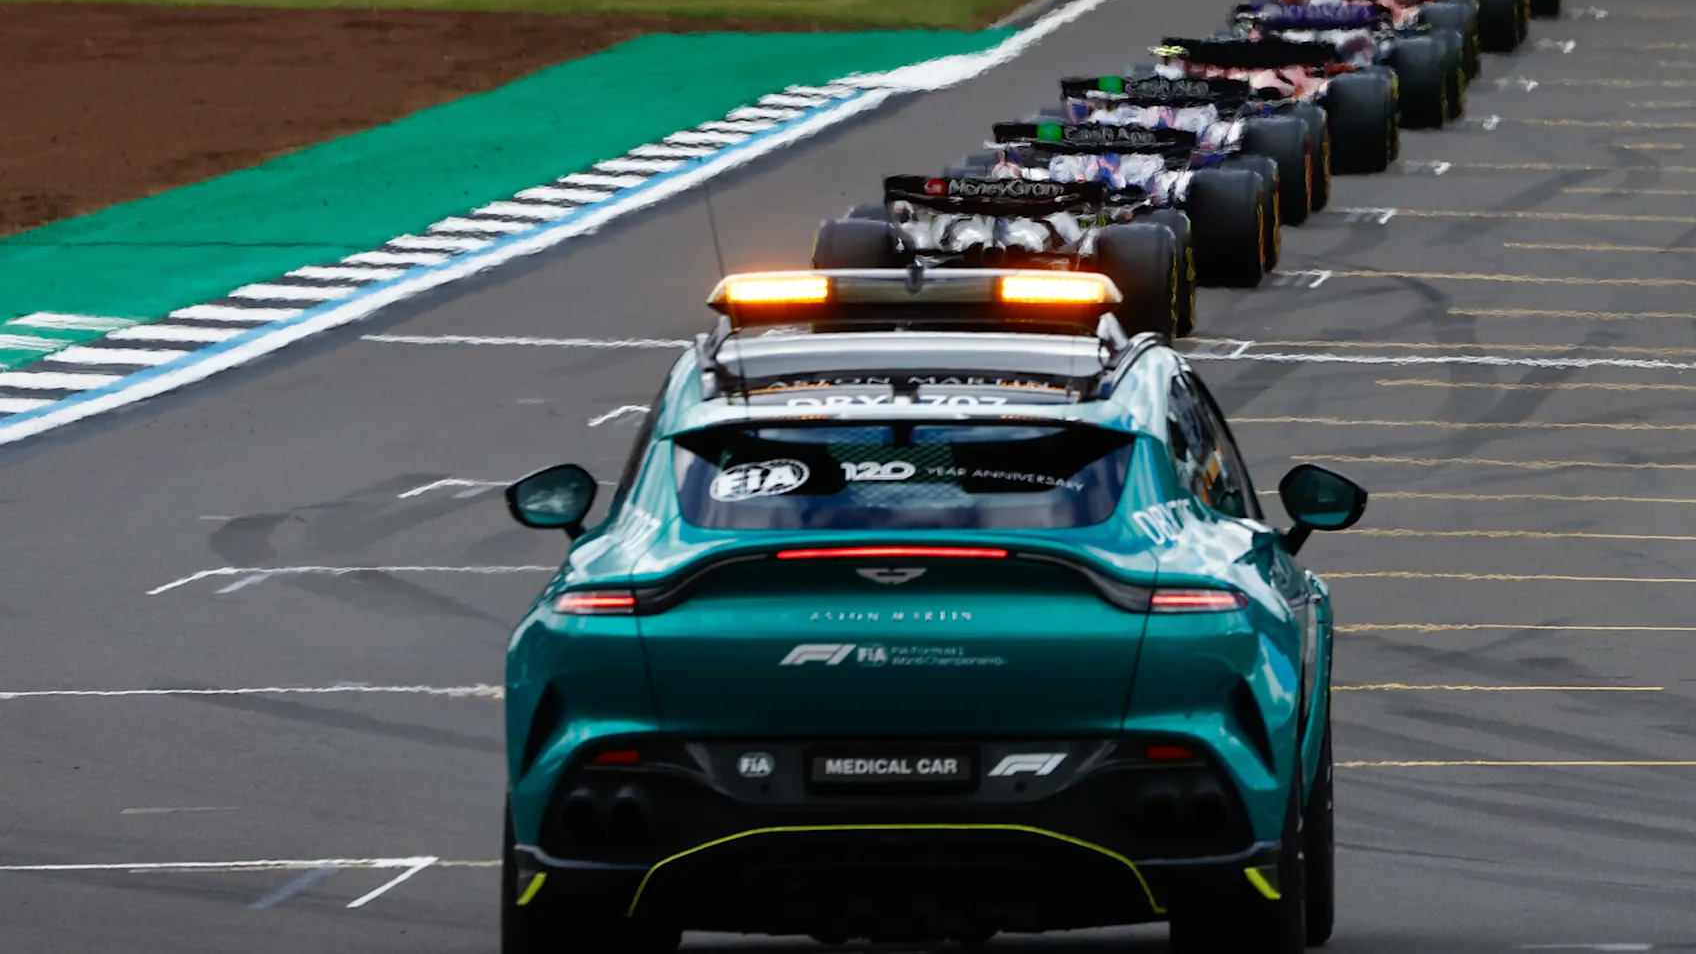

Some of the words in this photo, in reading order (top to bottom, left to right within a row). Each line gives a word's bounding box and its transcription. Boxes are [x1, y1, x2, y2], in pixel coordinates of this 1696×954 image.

[948, 179, 1064, 197] MoneyGram
[926, 466, 968, 478] YEAR
[972, 469, 1084, 493] ANNIVERSARY
[739, 758, 770, 774] FIA
[825, 759, 911, 775] MEDICAL
[916, 759, 959, 775] CAR
